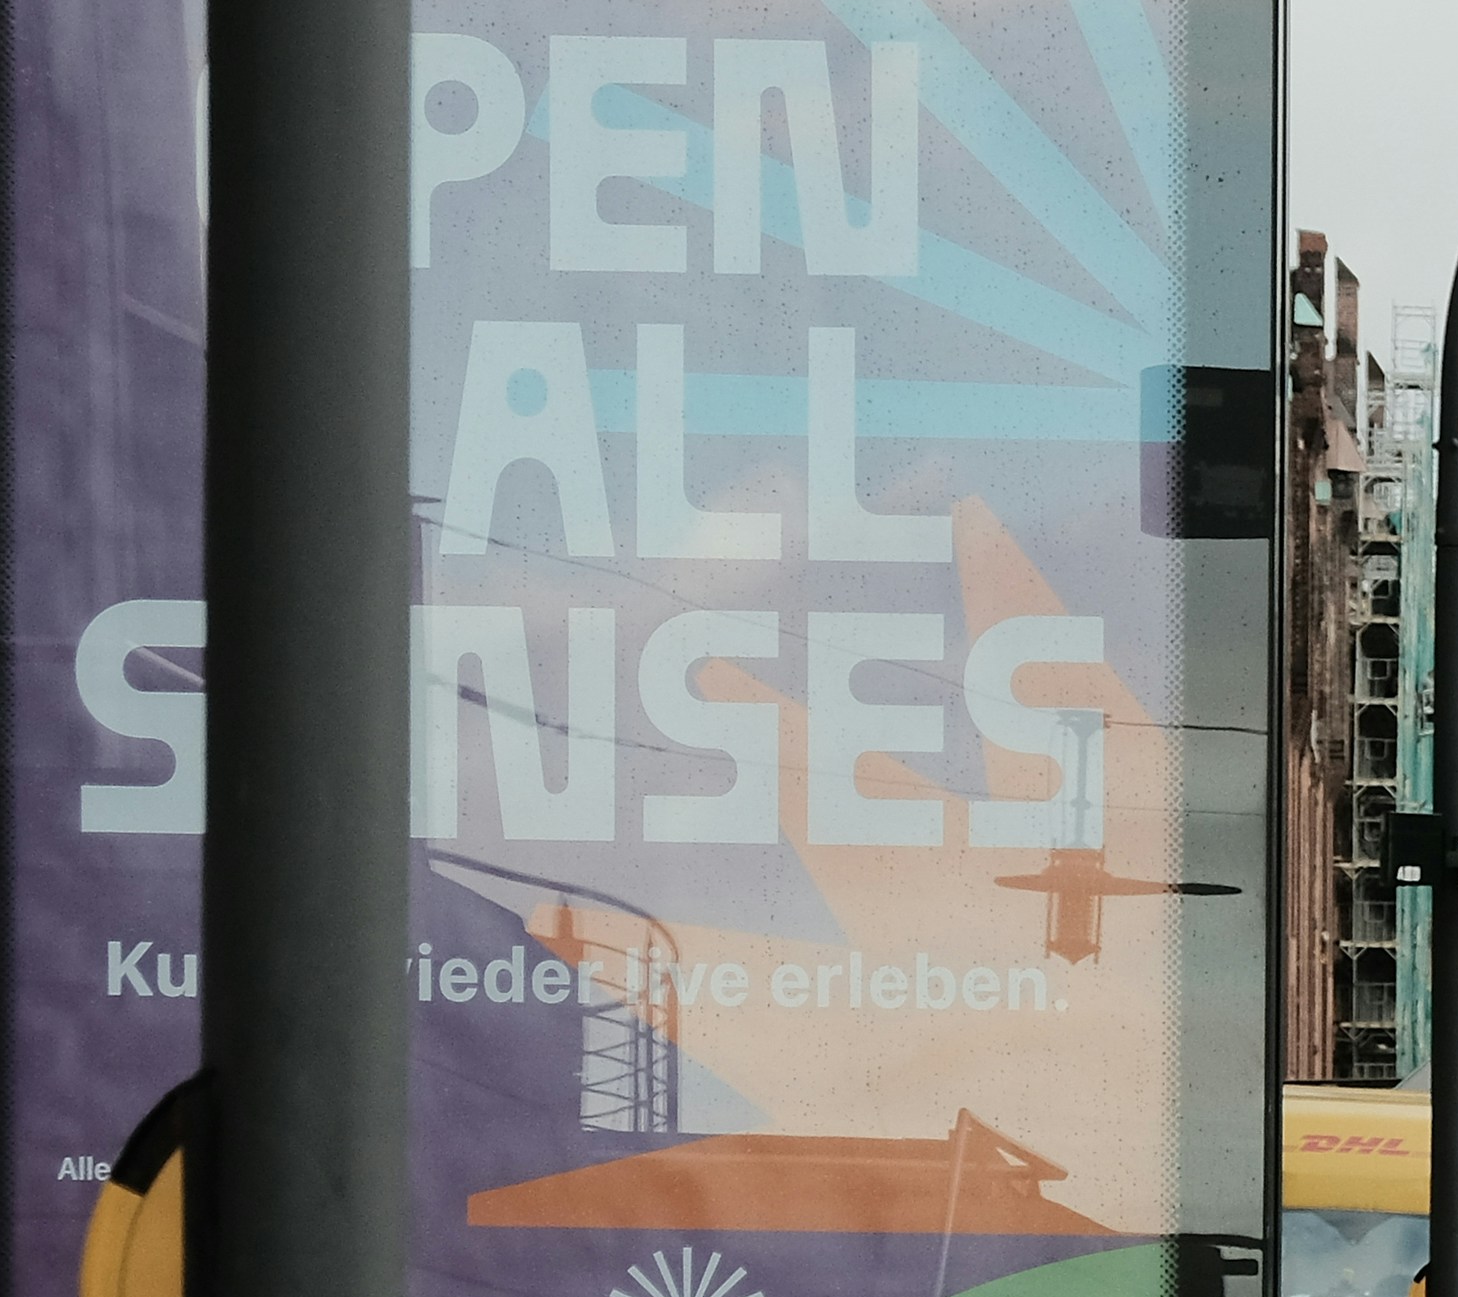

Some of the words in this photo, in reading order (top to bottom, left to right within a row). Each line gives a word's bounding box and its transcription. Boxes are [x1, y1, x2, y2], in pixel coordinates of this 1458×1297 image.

[410, 32, 919, 277] PEN
[439, 320, 953, 563] ALL
[75, 599, 1104, 849] SNSES
[405, 943, 604, 1004] ieder
[626, 947, 749, 1007] live
[771, 951, 1070, 1012] erleben.
[57, 1156, 112, 1182] Alle
[1300, 1134, 1410, 1156] DHL
